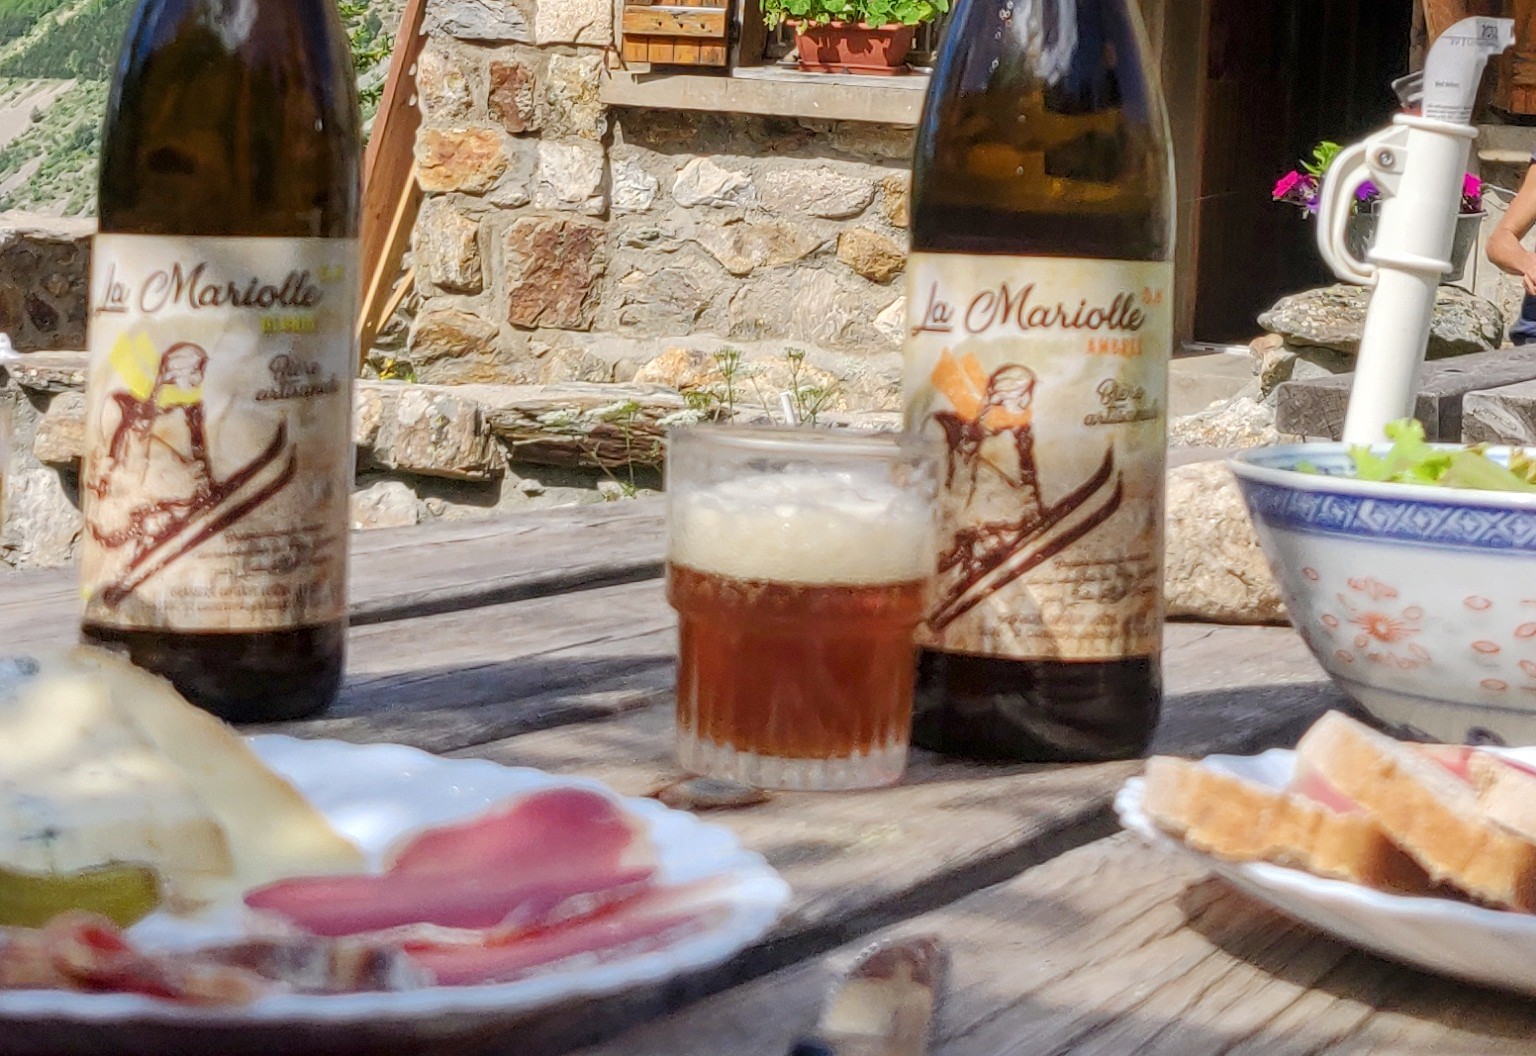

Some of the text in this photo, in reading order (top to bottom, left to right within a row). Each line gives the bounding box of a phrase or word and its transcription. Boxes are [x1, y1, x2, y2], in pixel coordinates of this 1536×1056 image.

[95, 261, 323, 314] La Mariolle
[910, 280, 1147, 337] La Mariolle
